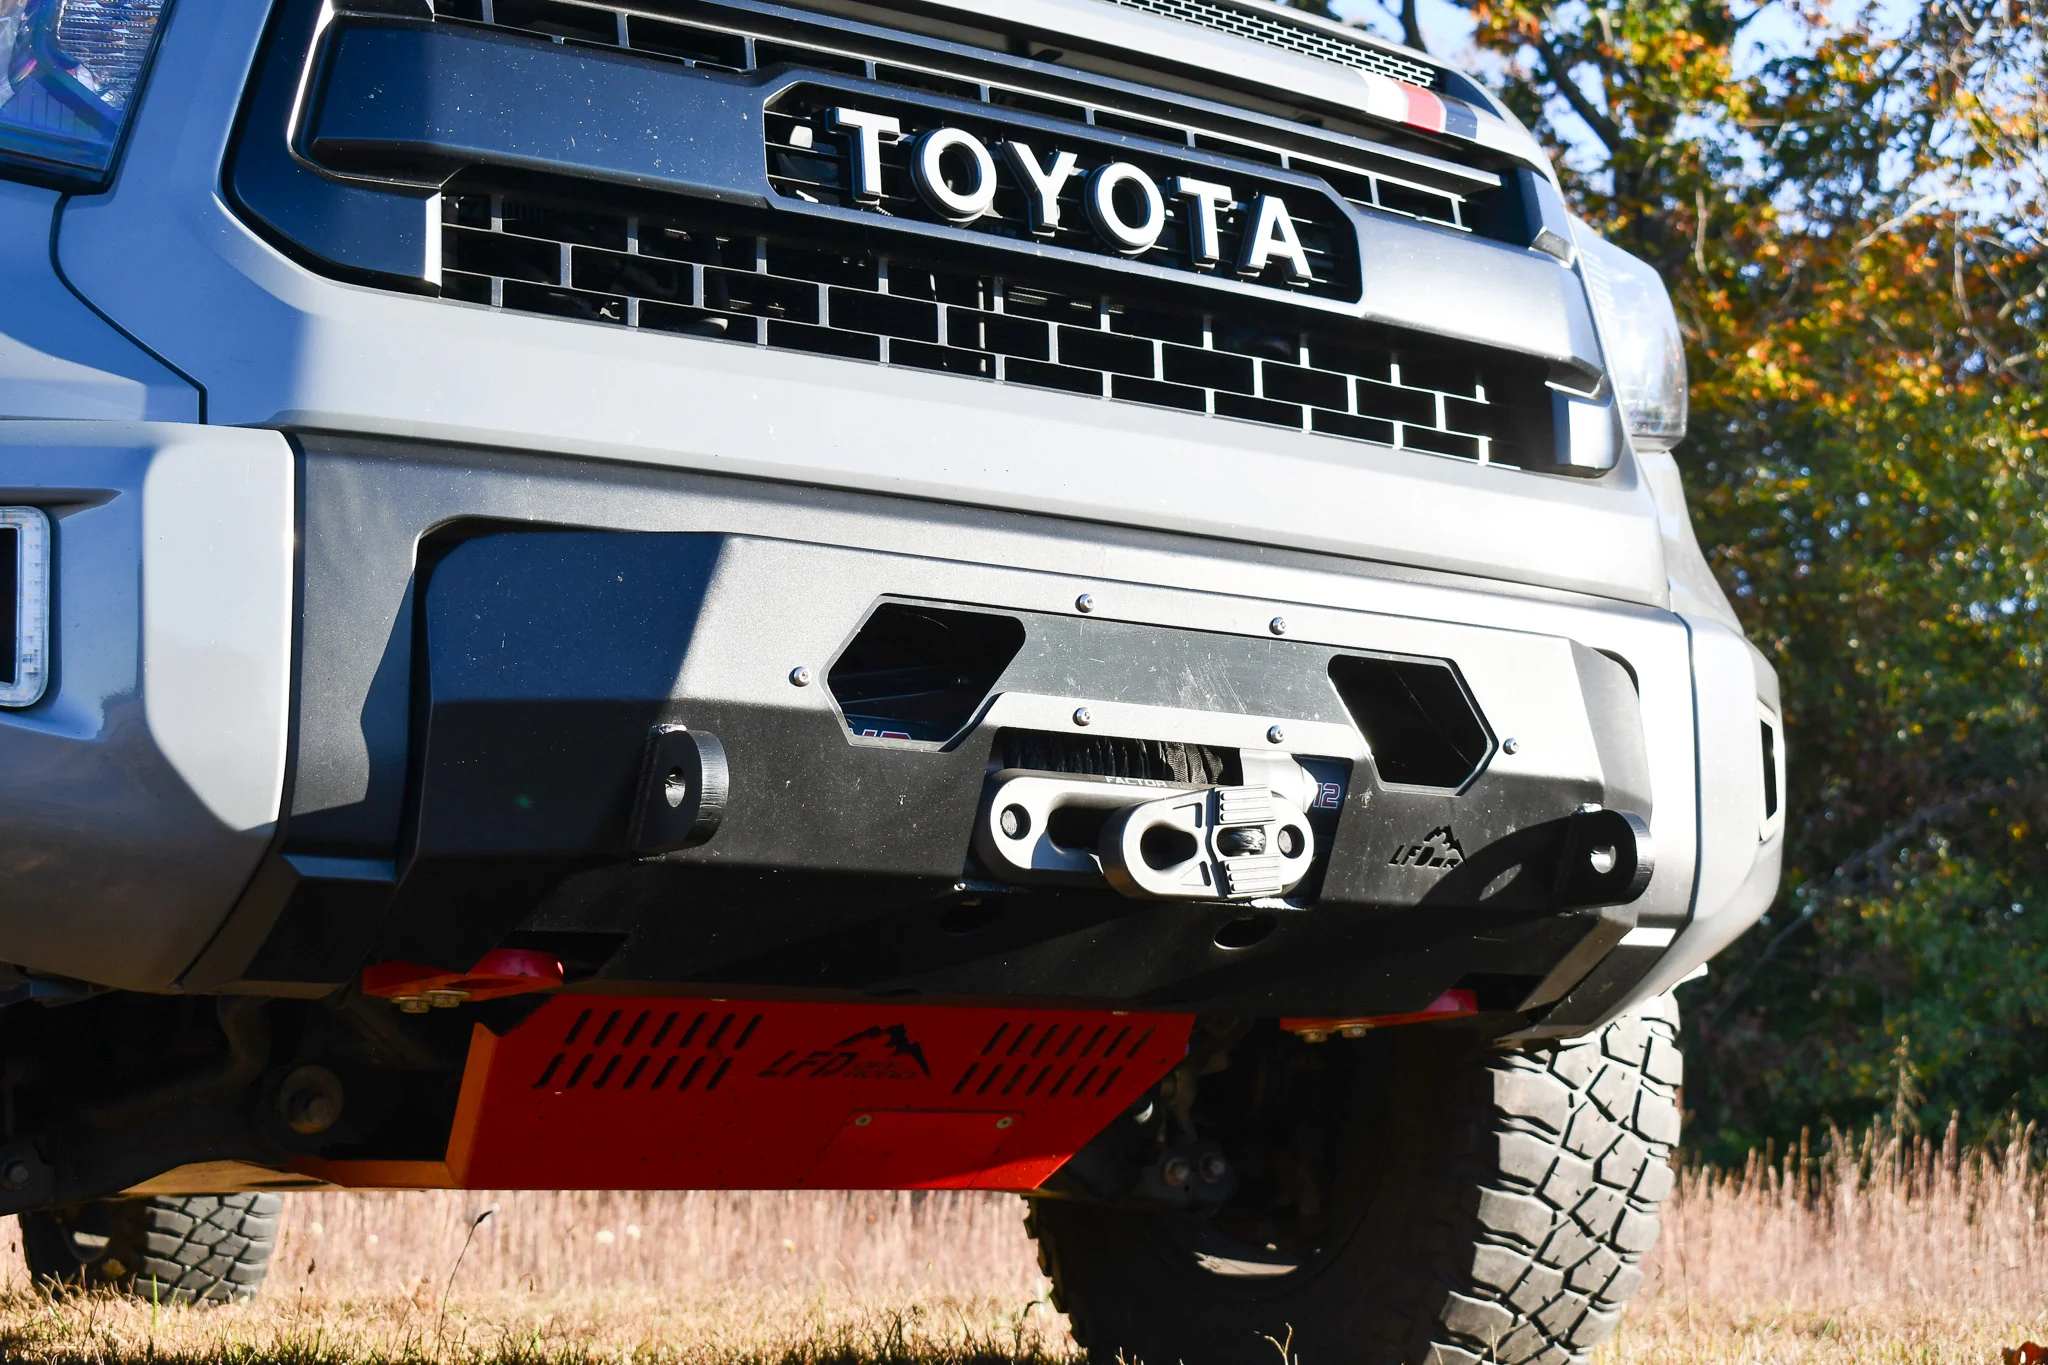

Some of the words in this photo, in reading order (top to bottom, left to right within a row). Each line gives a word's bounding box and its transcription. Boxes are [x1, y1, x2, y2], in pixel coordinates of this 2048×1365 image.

[827, 106, 1313, 286] TOYOTA
[1104, 775, 1168, 788] FACTOR
[757, 1050, 859, 1078] LFD
